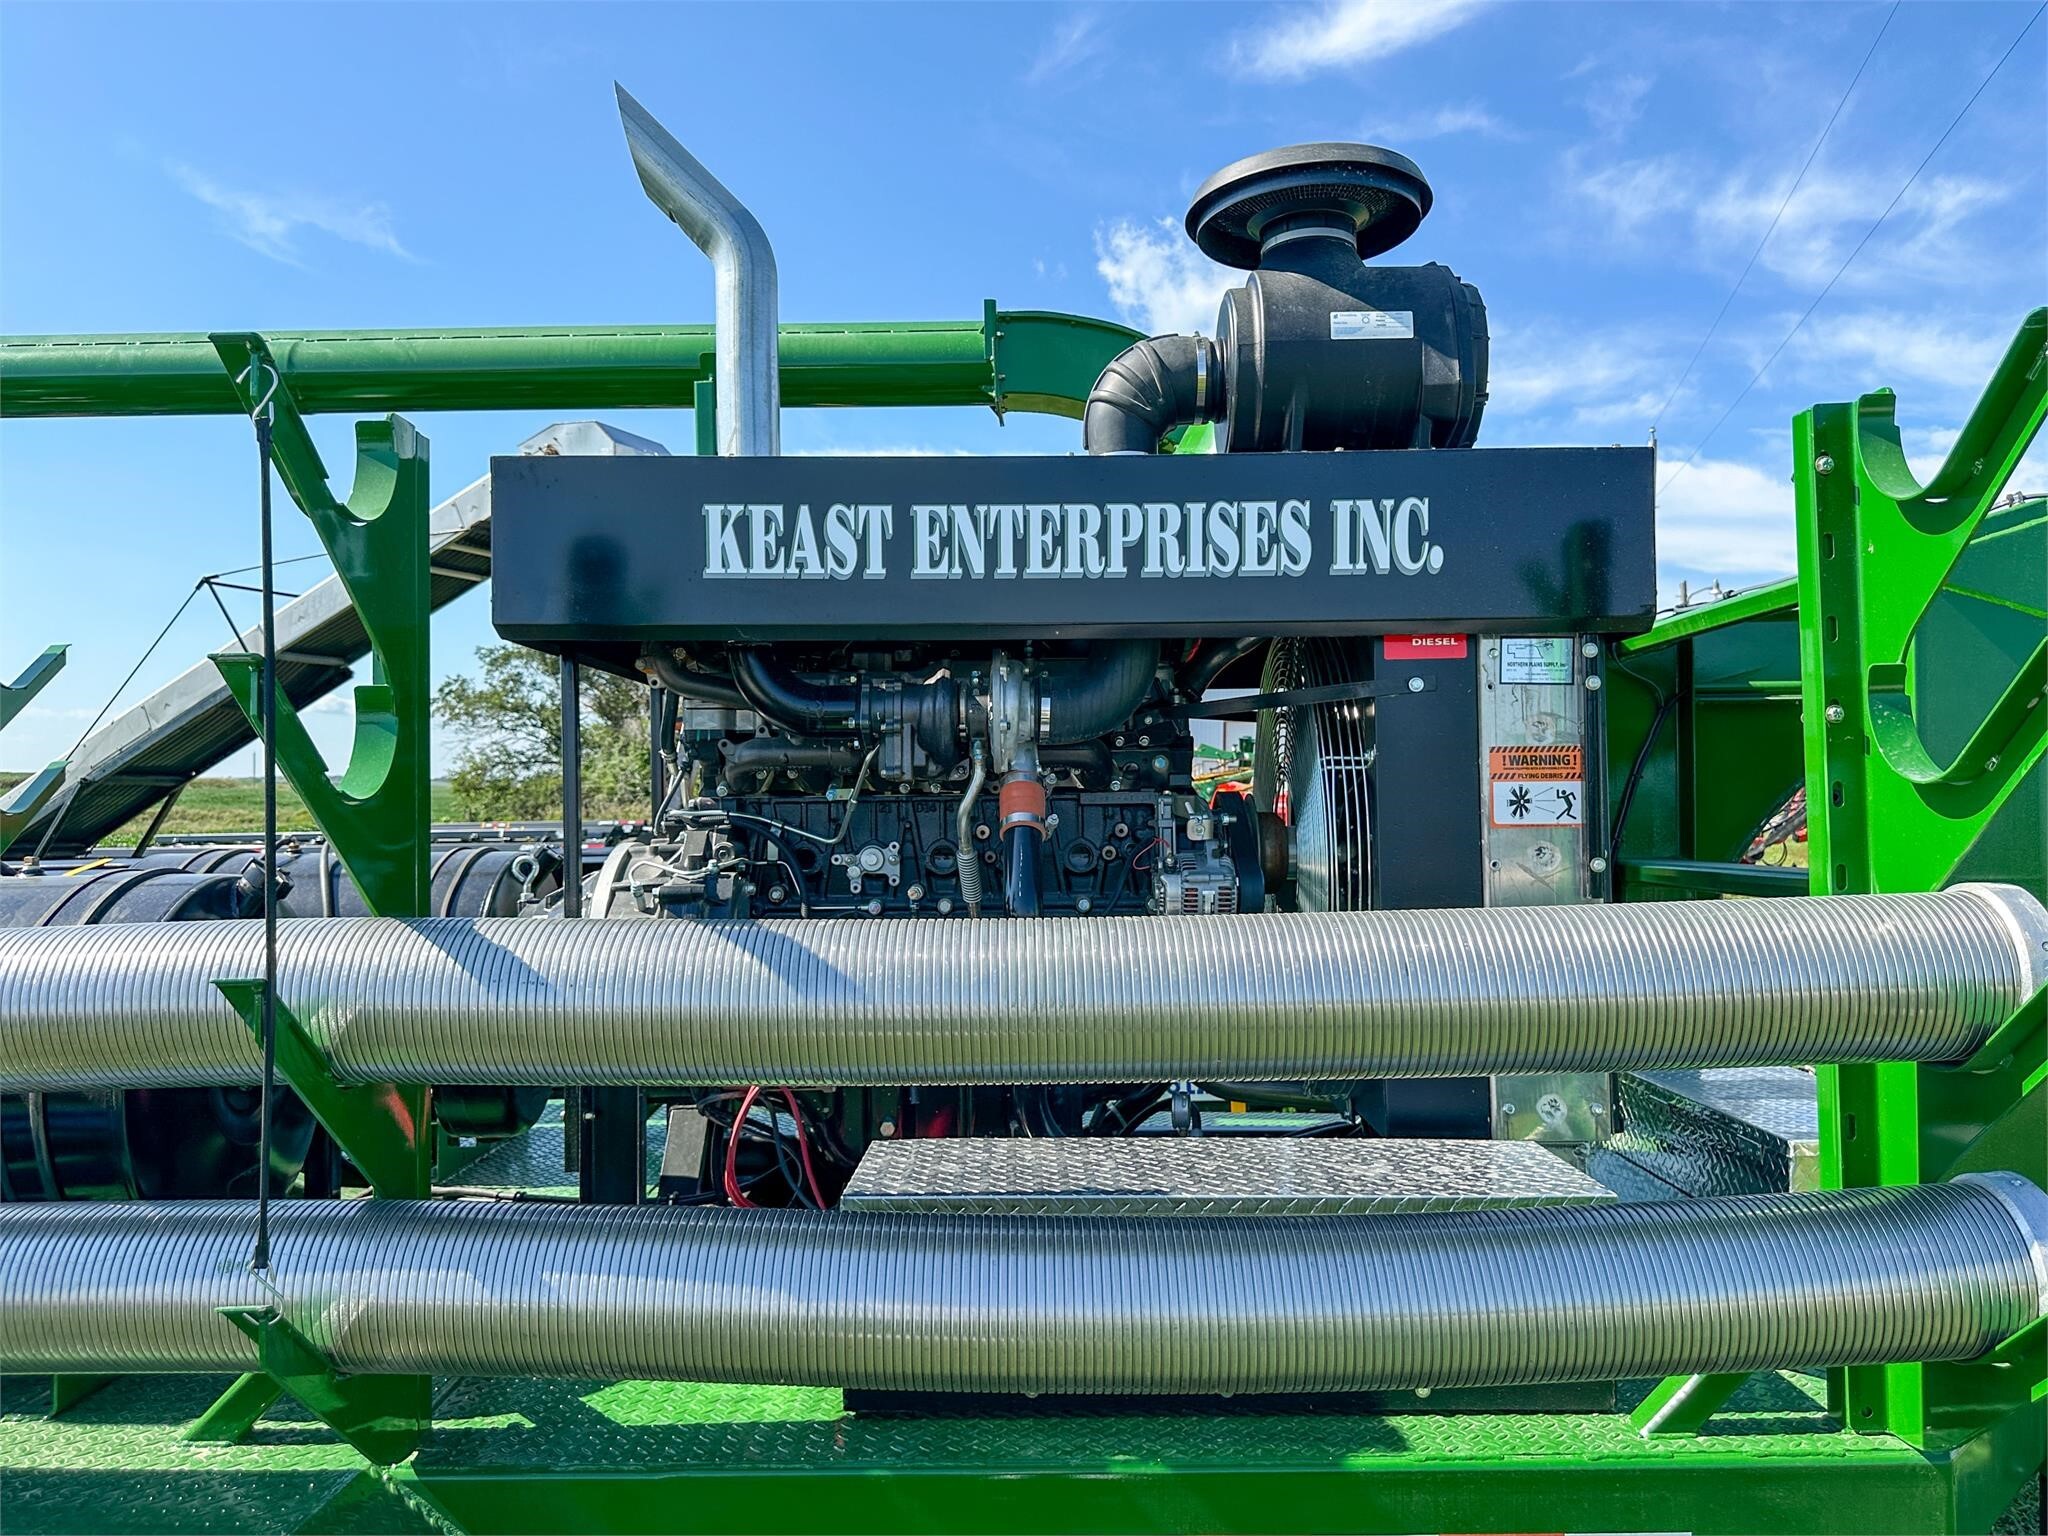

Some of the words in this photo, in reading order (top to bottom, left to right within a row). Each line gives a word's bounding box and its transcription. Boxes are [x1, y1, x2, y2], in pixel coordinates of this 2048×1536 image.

[702, 502, 893, 580] KEAST
[910, 500, 1312, 579] ENTERPRISES
[1329, 497, 1444, 575] INC.
[1412, 637, 1459, 646] DIESEL
[1508, 754, 1570, 766] WARNING
